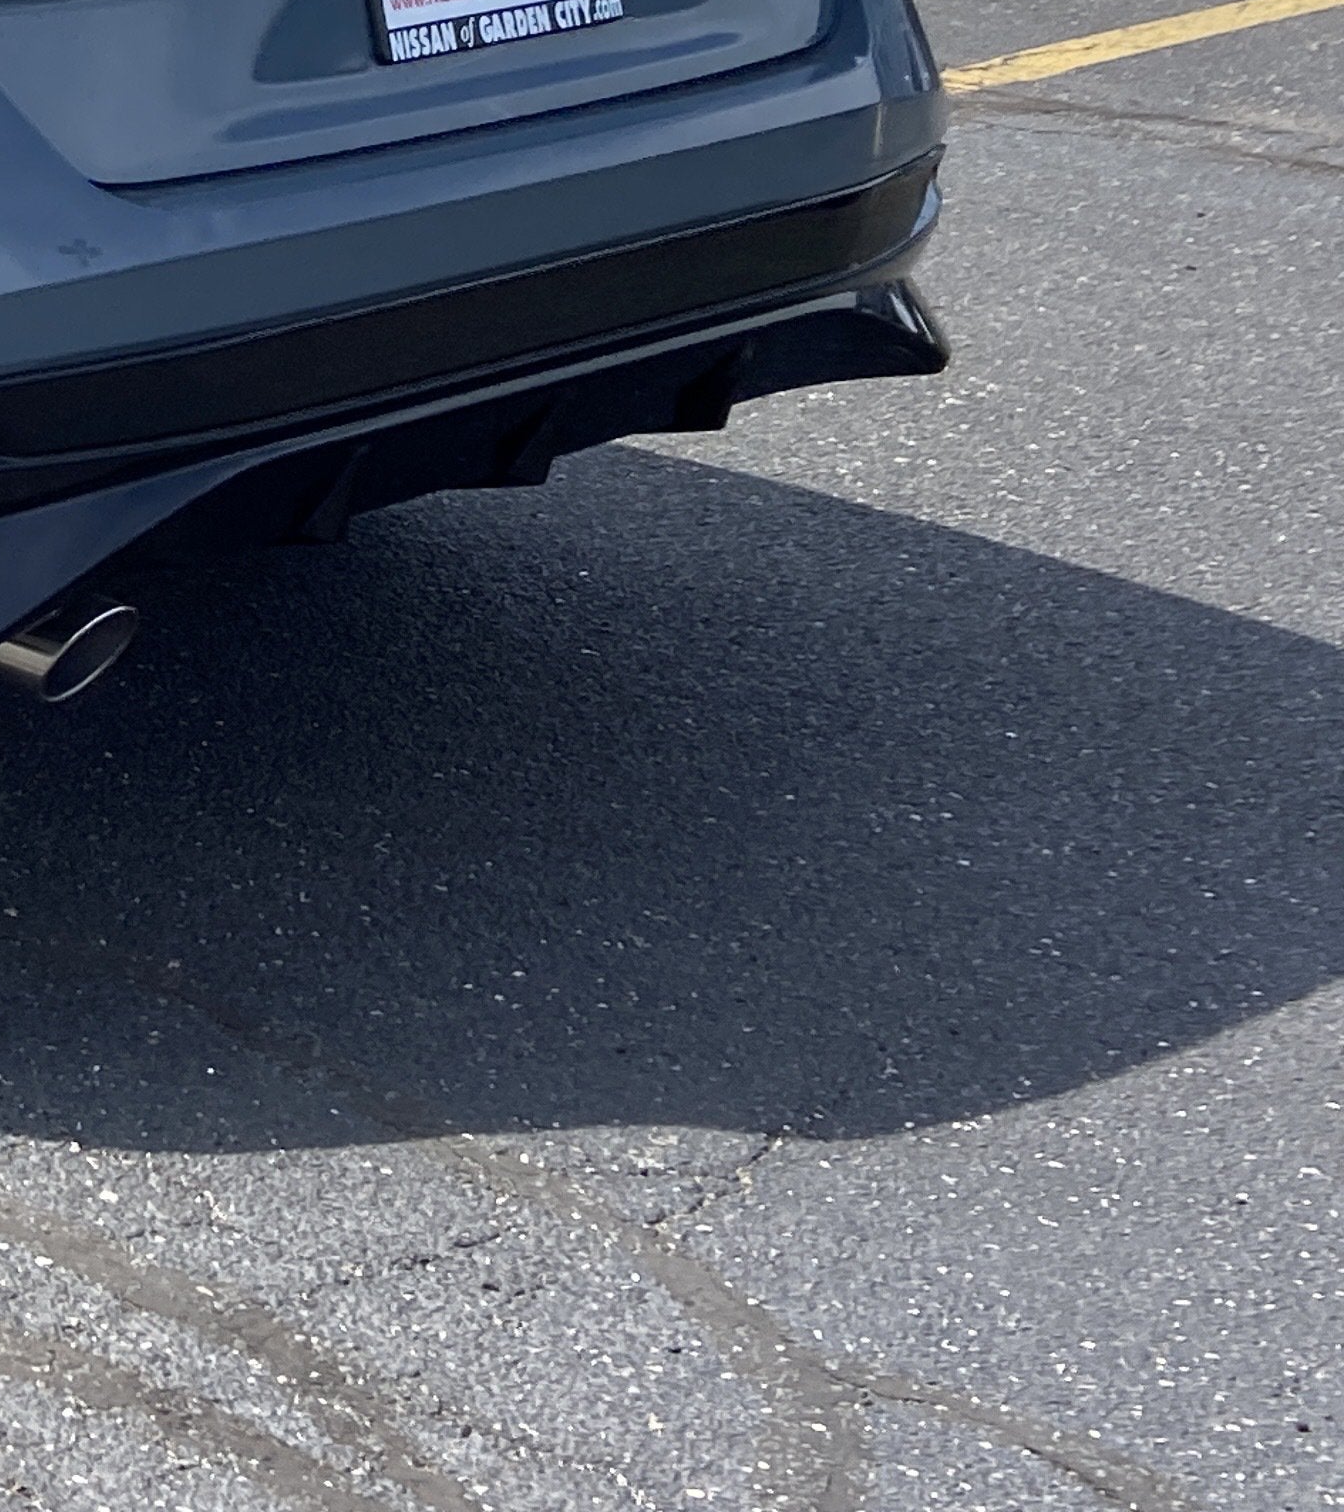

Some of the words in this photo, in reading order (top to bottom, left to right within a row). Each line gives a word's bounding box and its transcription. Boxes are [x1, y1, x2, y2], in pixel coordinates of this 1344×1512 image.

[388, 22, 458, 62] NISSAN
[460, 18, 476, 47] of
[478, 3, 552, 45] GARDEN
